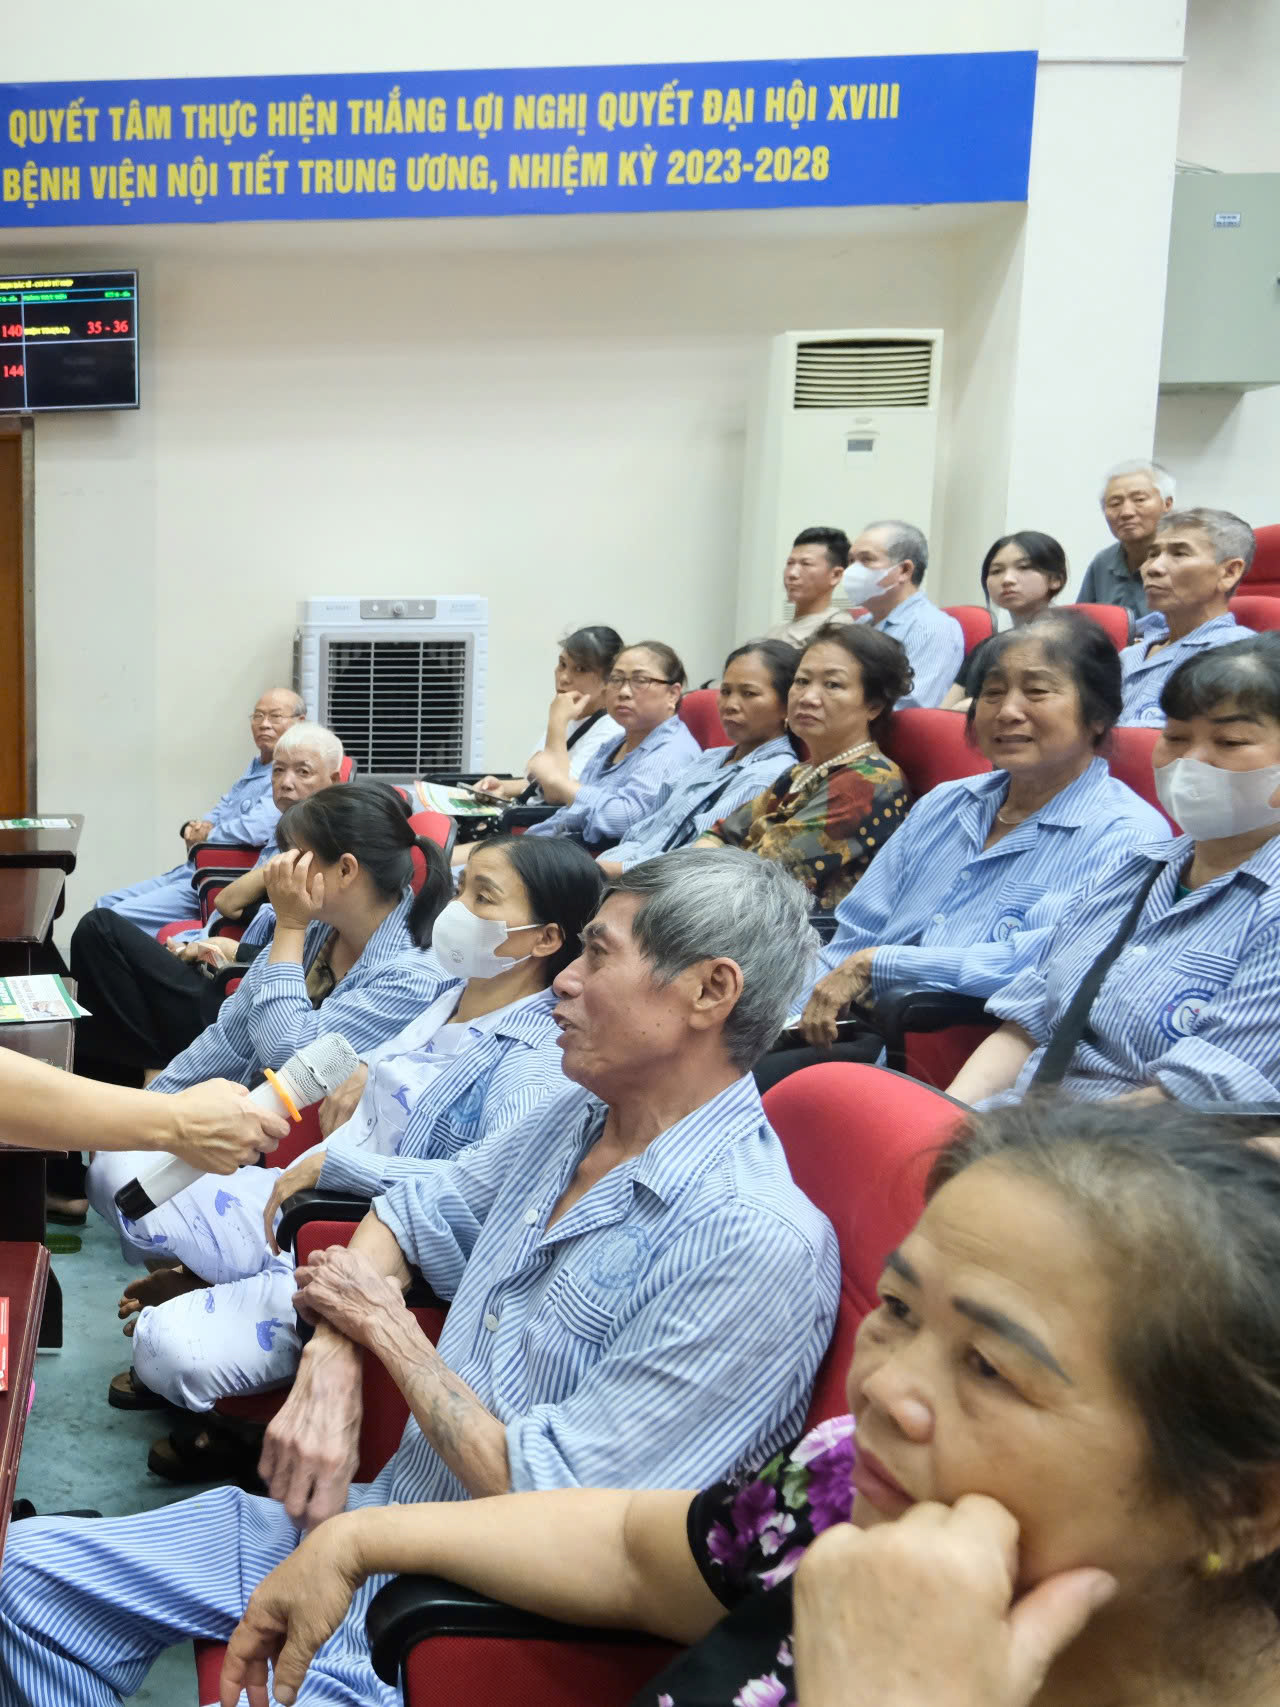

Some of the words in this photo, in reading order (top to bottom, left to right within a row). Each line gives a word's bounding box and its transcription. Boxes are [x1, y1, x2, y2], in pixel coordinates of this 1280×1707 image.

[9, 96, 99, 146] QUYẾT
[109, 99, 171, 140] TÂM
[182, 99, 257, 144] THỰC
[268, 94, 337, 142] HIỆN
[348, 85, 446, 133] THẮNG
[458, 93, 503, 137] LỢI
[515, 93, 587, 135] NGHỊ
[598, 80, 693, 130] QUYẾT
[703, 87, 754, 130] ĐẠI
[766, 80, 817, 128] HỘI
[828, 83, 899, 120] XVIII
[3, 159, 80, 208] BỆNH
[91, 158, 157, 206] VIỆN
[168, 156, 218, 204] NỘI
[229, 149, 289, 194] TIẾT
[299, 157, 396, 193] TRUNG
[408, 153, 497, 192] ƯƠNG,
[509, 145, 608, 193] NHIỆM
[619, 144, 656, 185] KỲ
[667, 145, 829, 184] 2023-2028
[2, 324, 23, 338] 140
[87, 321, 102, 334] 35
[113, 320, 128, 333] 36
[3, 364, 24, 378] 144
